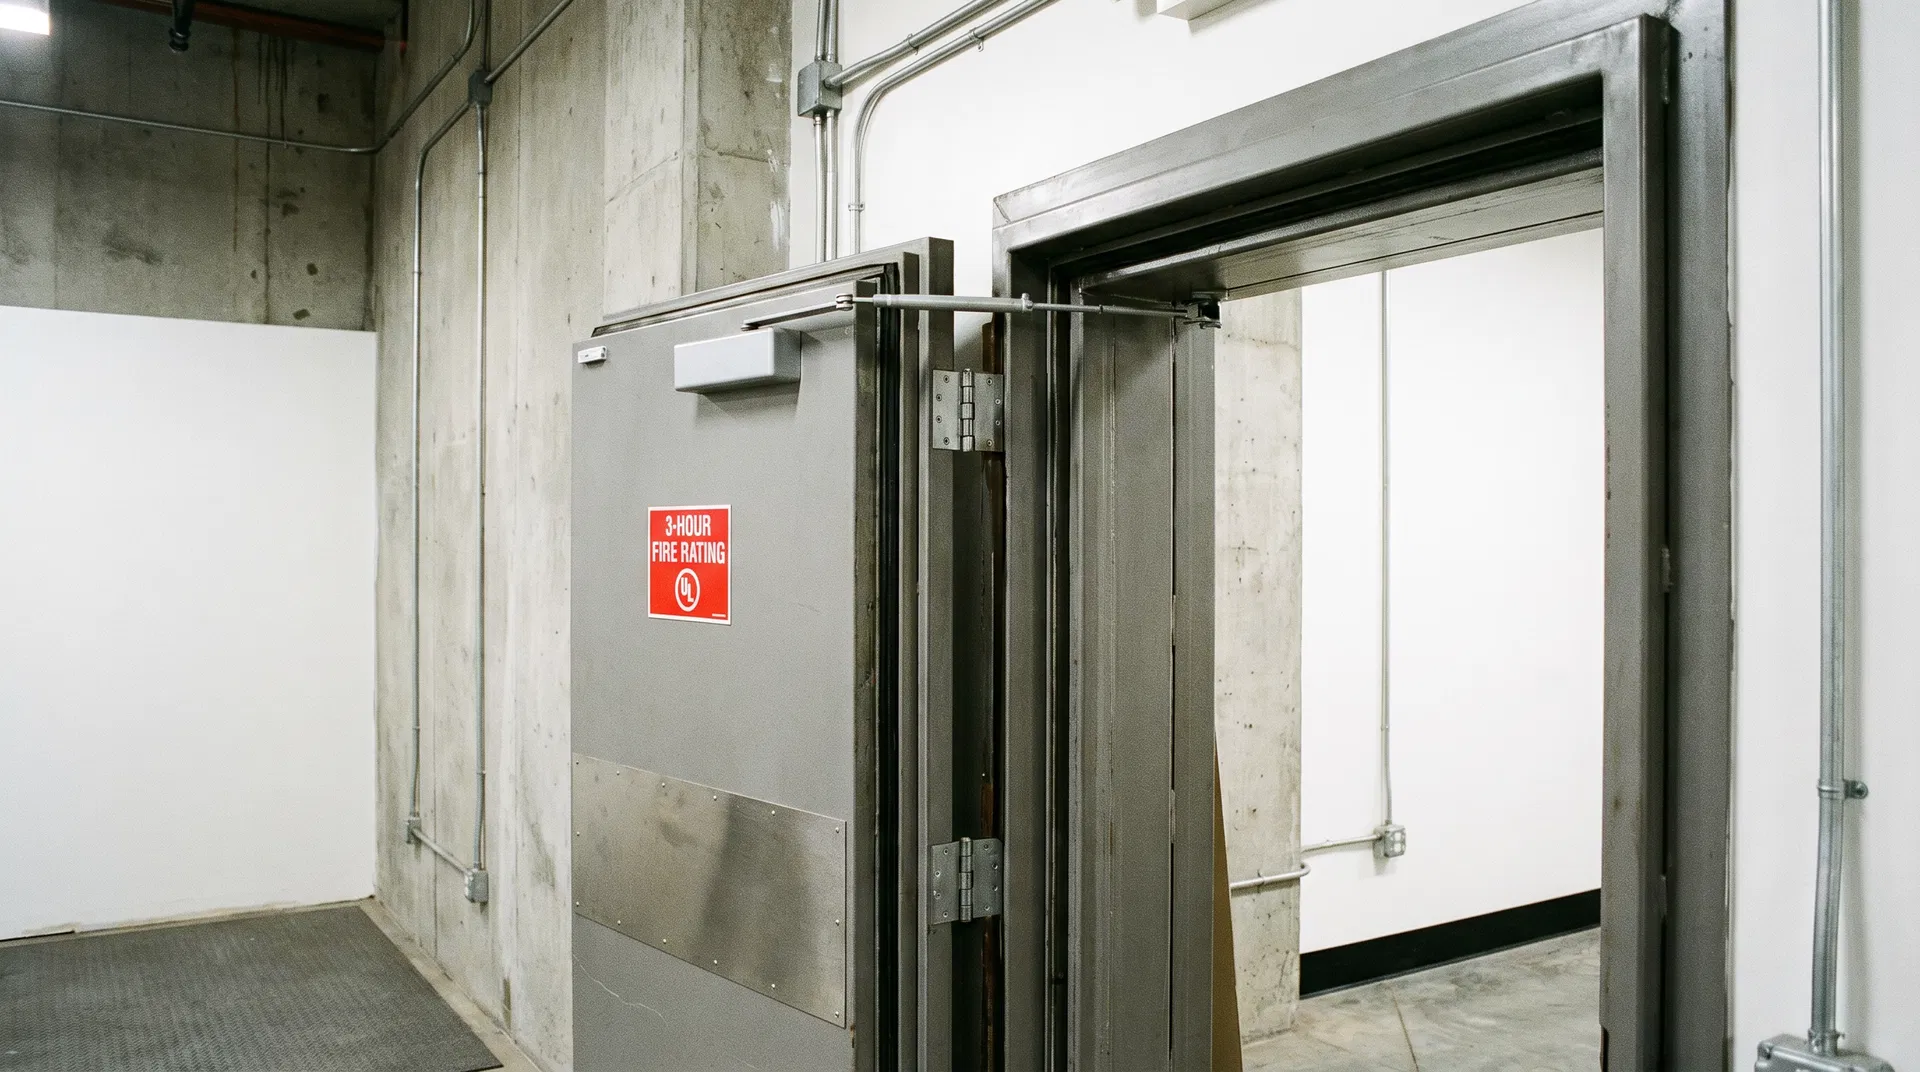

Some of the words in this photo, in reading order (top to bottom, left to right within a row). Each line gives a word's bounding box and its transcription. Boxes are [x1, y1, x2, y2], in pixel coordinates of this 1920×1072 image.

[665, 514, 711, 537] 3-HOUR
[652, 541, 678, 563] FIRE
[680, 541, 726, 565] RATING
[680, 577, 694, 603] UL
